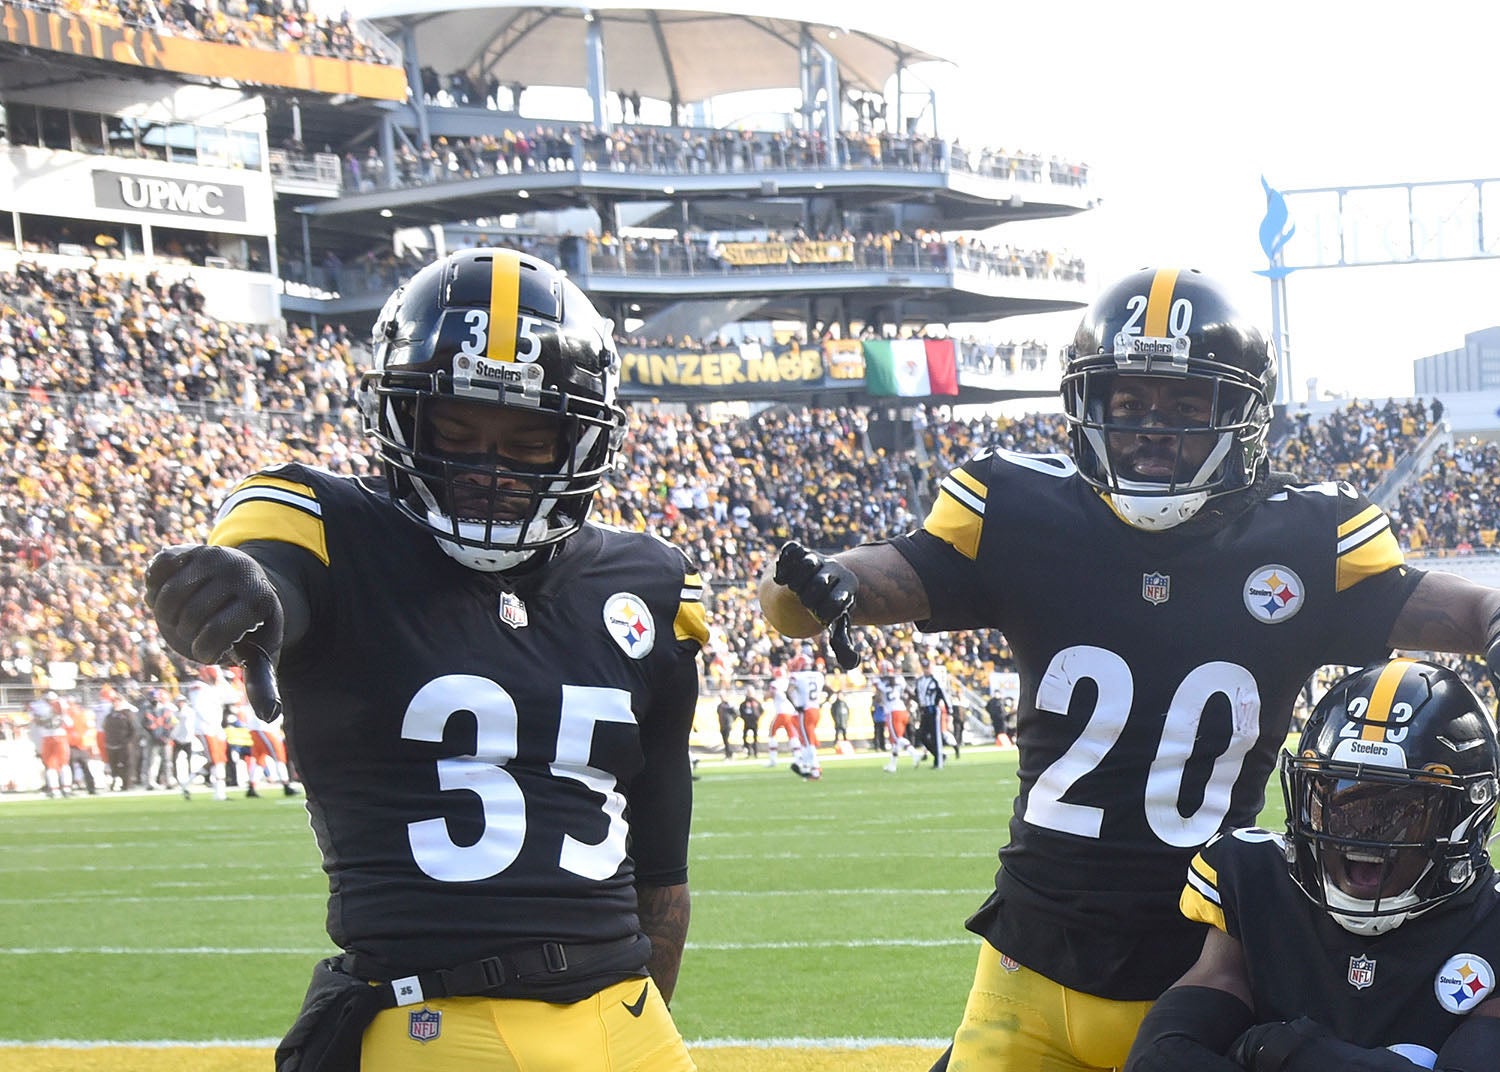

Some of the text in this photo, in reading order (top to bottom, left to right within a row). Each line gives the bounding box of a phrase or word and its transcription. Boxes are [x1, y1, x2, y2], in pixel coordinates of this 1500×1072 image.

[118, 176, 225, 216] UPMC
[1121, 295, 1193, 338] 20
[461, 309, 542, 363] 35
[1133, 339, 1172, 354] Steelers
[476, 361, 522, 382] Steelers
[748, 350, 824, 384] MOB
[1147, 586, 1166, 599] NFL
[1249, 587, 1272, 597] Steelers
[1339, 696, 1413, 743] 23
[1024, 645, 1261, 847] 20
[1350, 741, 1389, 757] Steelers
[401, 674, 639, 882] 35
[1352, 969, 1369, 983] NFL
[1439, 976, 1462, 986] Steelers
[400, 986, 413, 996] 35
[413, 1022, 436, 1037] NFL
